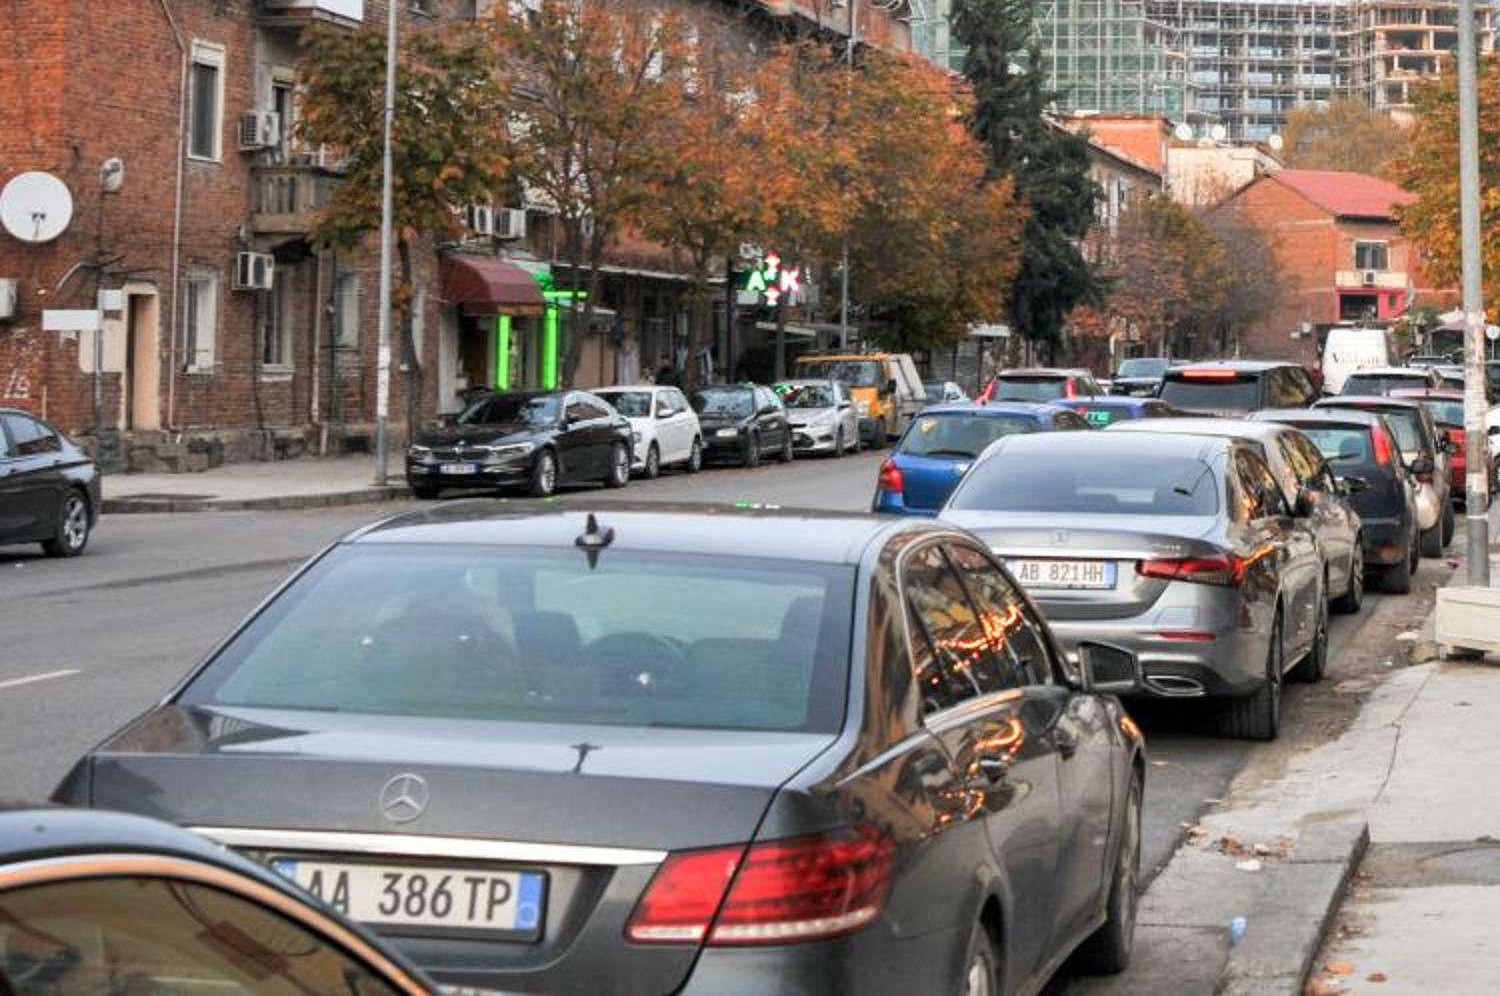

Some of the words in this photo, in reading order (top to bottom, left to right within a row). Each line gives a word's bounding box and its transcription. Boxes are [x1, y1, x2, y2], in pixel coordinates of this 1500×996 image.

[1019, 563, 1040, 580] AB
[1048, 563, 1078, 581] 821
[1083, 564, 1104, 583] HH
[308, 870, 349, 915] AA
[378, 873, 453, 918] 386
[463, 877, 512, 922] TP
